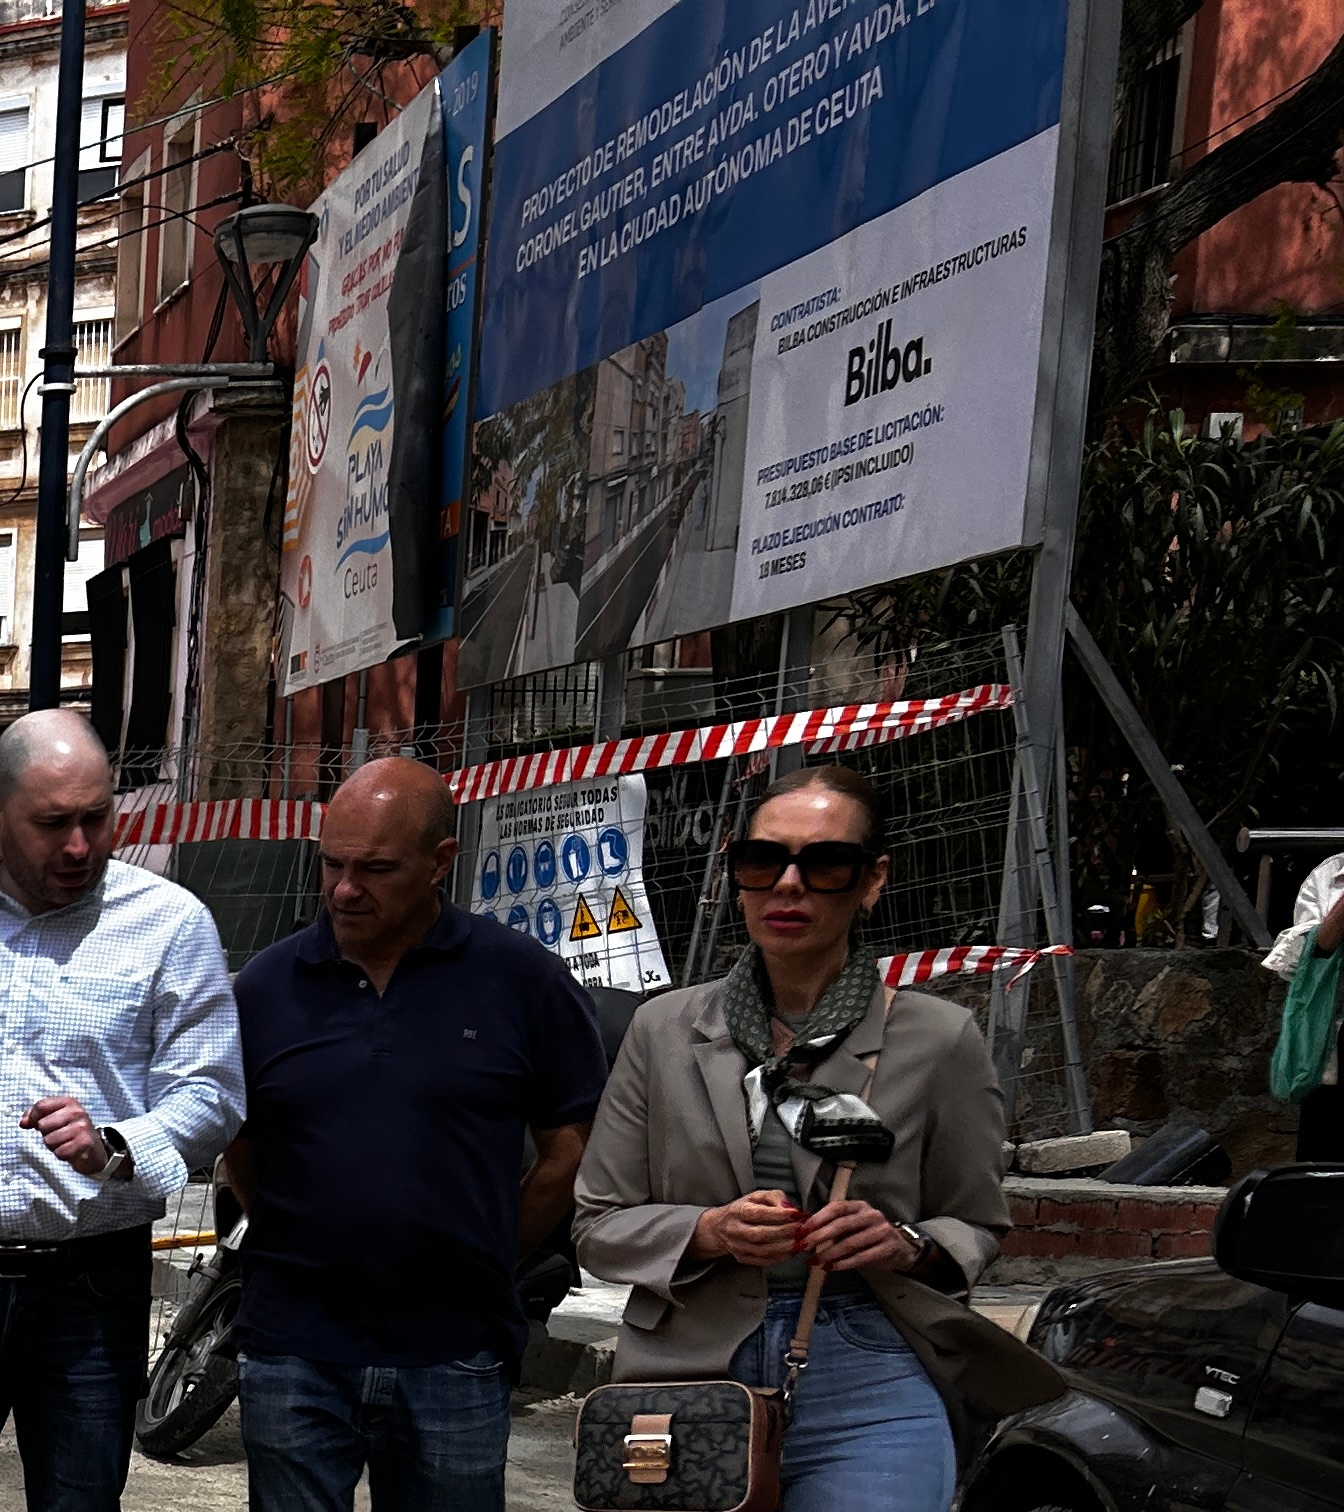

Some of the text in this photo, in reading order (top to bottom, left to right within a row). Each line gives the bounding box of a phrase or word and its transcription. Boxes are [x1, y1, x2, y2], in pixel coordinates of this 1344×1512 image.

[515, 0, 912, 273] CORONEL GAUTIER, ENTRE AVDA. OTERO Y AVDA.
[521, 0, 848, 228] PROYECTO DE REMODELACIÓN DE LA AVE
[577, 65, 886, 280] EN LA CIUDAD AUTÓNOMA DE CEUTA
[770, 286, 842, 333] CONTRATISTA:
[777, 225, 1027, 355] BILBA CONSTRUCCIÓN E INFRAESTRUCTURAS
[843, 318, 933, 407] Bilba.
[345, 438, 383, 500] PLAYA
[756, 402, 946, 486] PRESUPUESTO BASE DE LICITACIÓN:
[853, 442, 915, 482] INCLUIDO)
[751, 492, 906, 556] PLAZO EJECUCIÓN CONTRATO:
[344, 562, 379, 599] Ceuta
[770, 551, 806, 577] MESES
[499, 807, 605, 839] LAS NORMAS DE SEGURIDAD
[505, 795, 552, 819] OBLIGATORIO
[580, 785, 619, 807] TODAS
